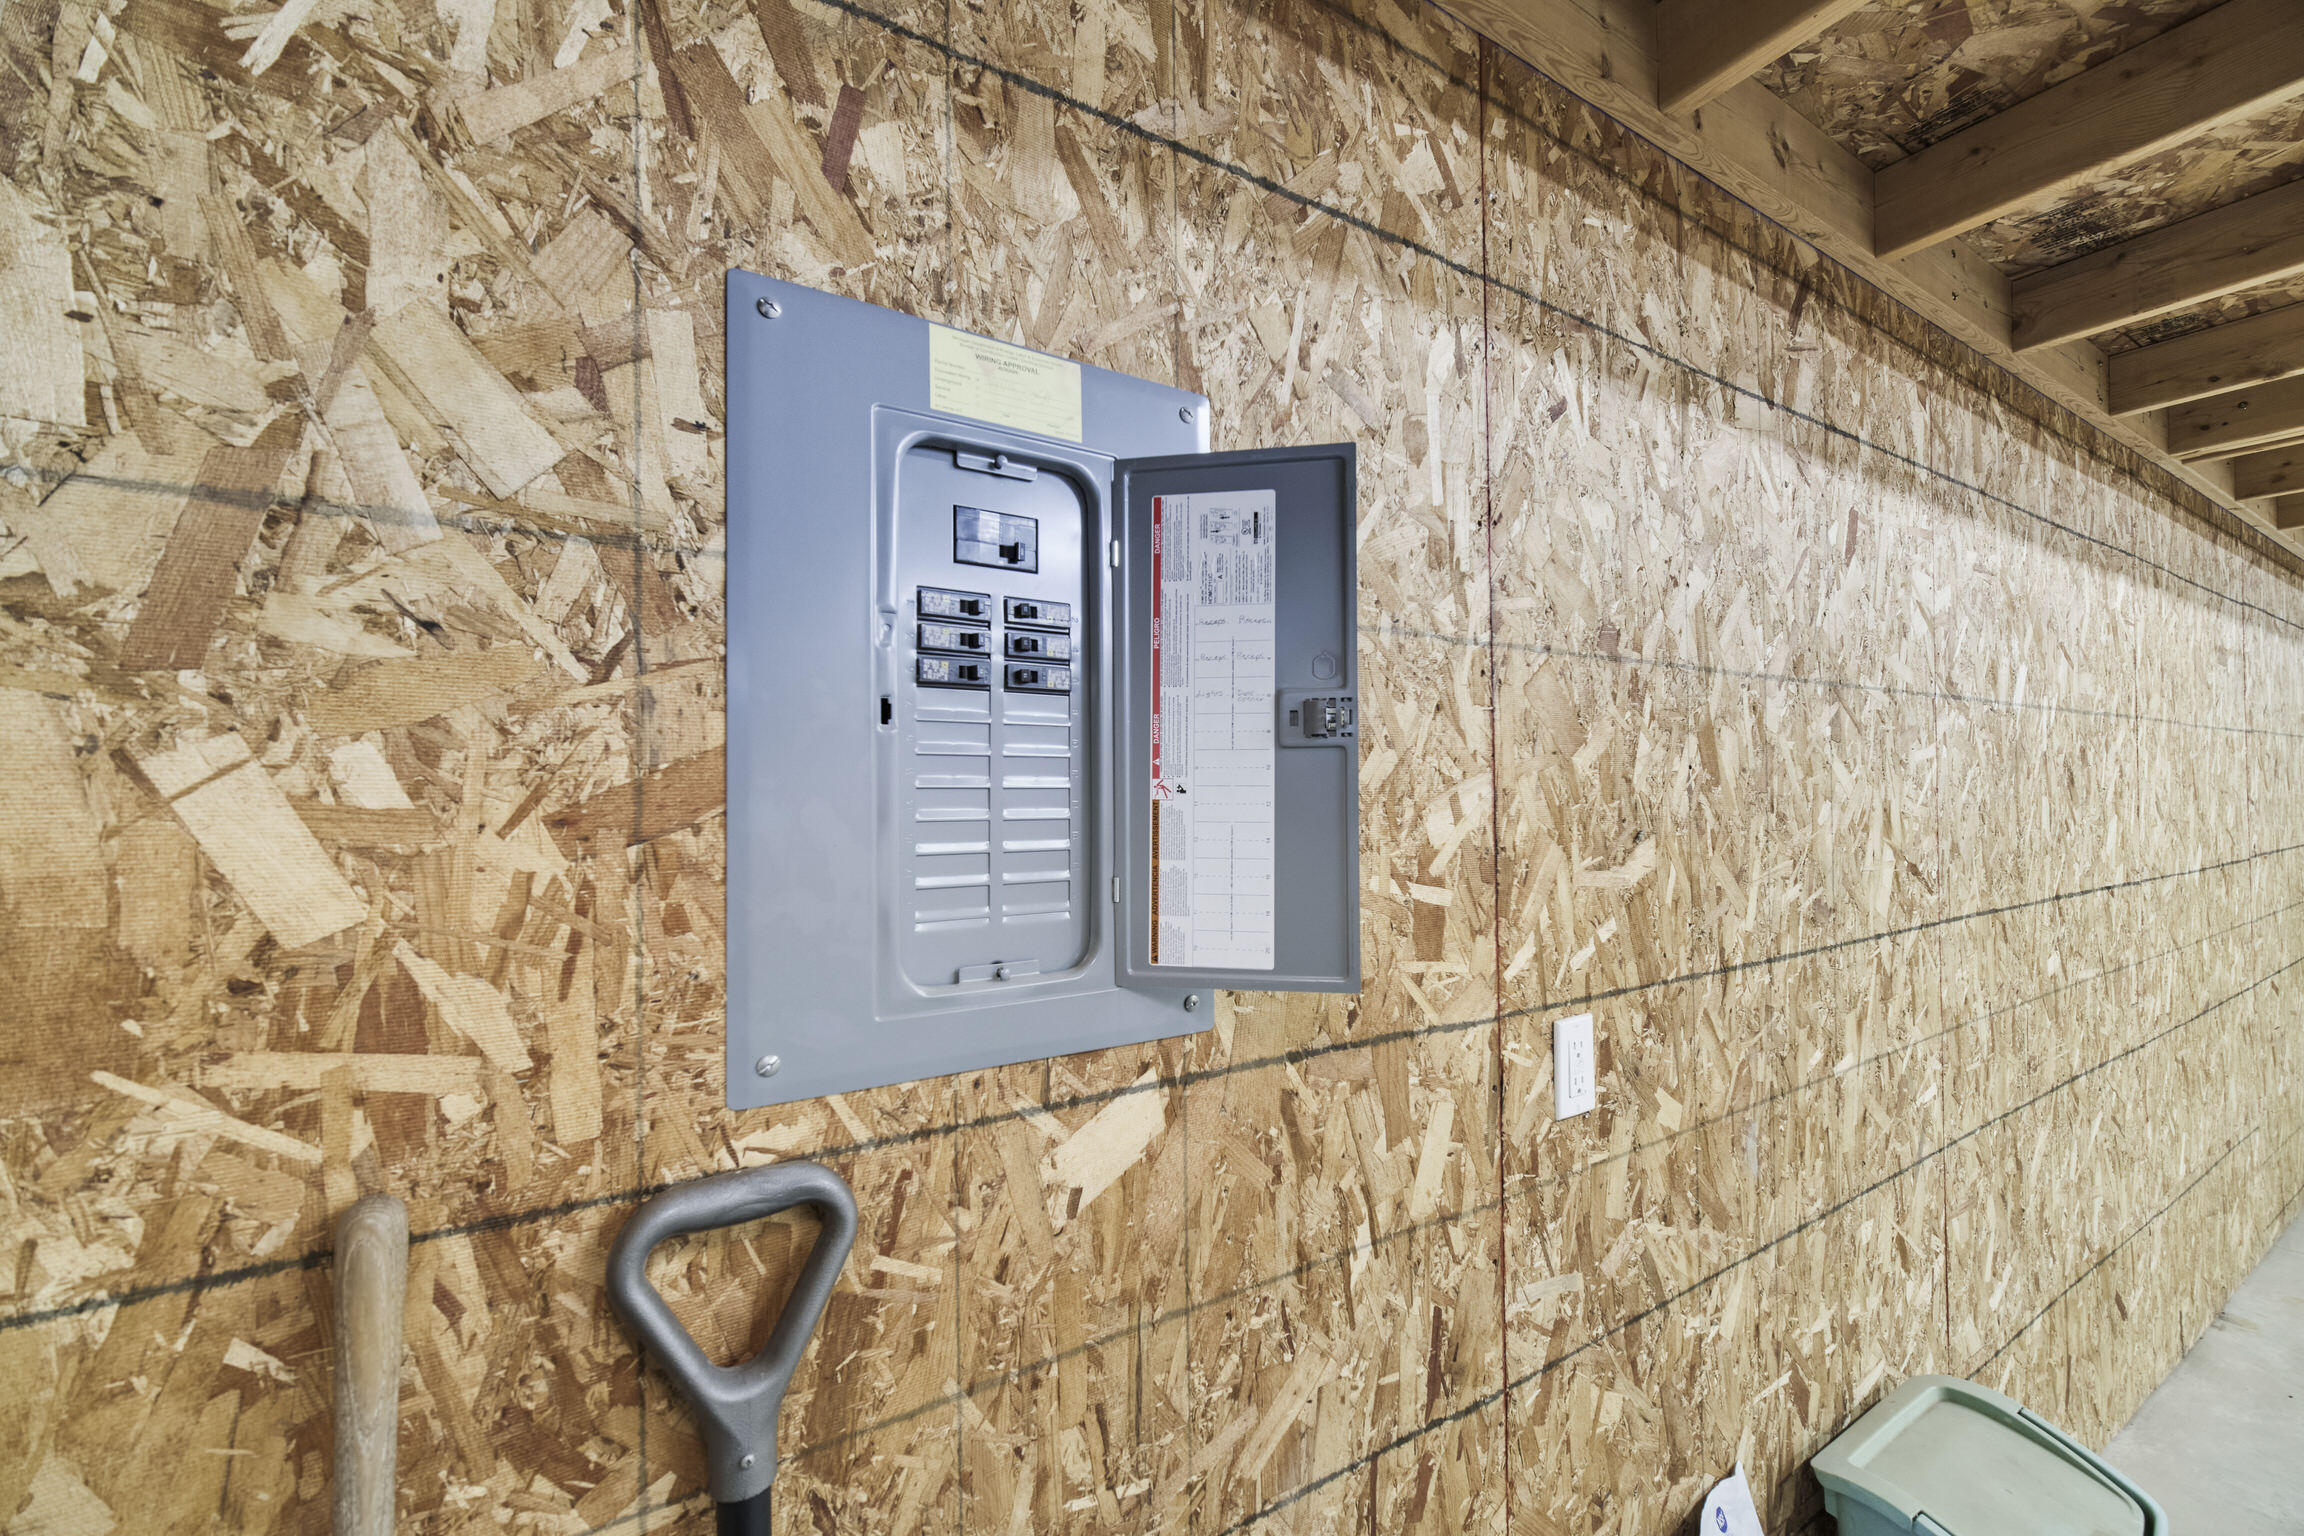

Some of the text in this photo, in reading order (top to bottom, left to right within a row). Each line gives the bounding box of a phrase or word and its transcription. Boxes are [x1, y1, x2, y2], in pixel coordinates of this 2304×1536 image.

[975, 353, 1001, 366] WIRING
[1002, 361, 1040, 375] APPROVAL
[1152, 801, 1160, 860] AVERTISSEMENT
